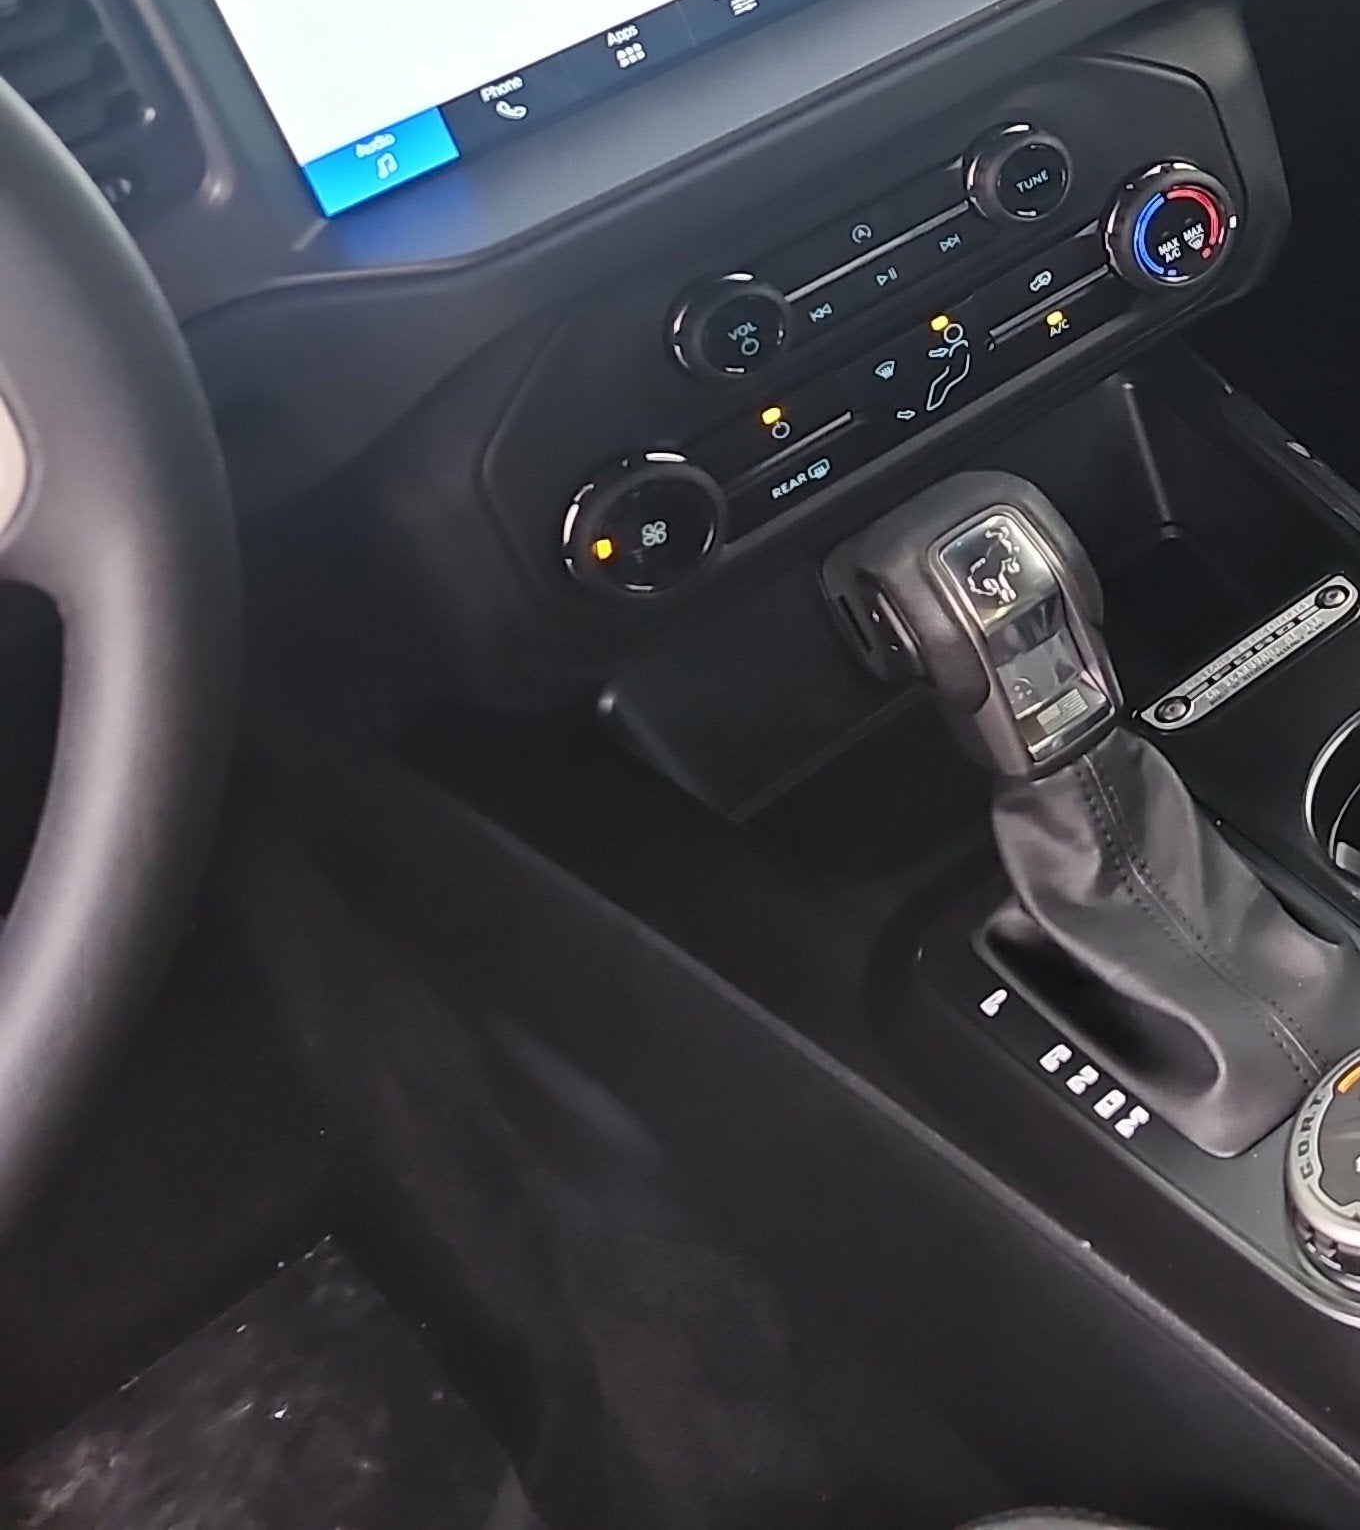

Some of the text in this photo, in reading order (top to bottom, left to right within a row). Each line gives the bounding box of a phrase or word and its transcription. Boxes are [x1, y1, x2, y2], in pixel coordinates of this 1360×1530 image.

[606, 24, 639, 48] Apps
[479, 75, 524, 104] Phone
[355, 131, 396, 158] Audio
[1016, 169, 1050, 194] TUNE
[1182, 222, 1205, 240] MAX
[1157, 237, 1181, 256] MAX
[1165, 248, 1182, 264] A/C
[727, 321, 757, 341] VOL
[1049, 318, 1071, 338] A/C
[771, 472, 807, 500] REAR
